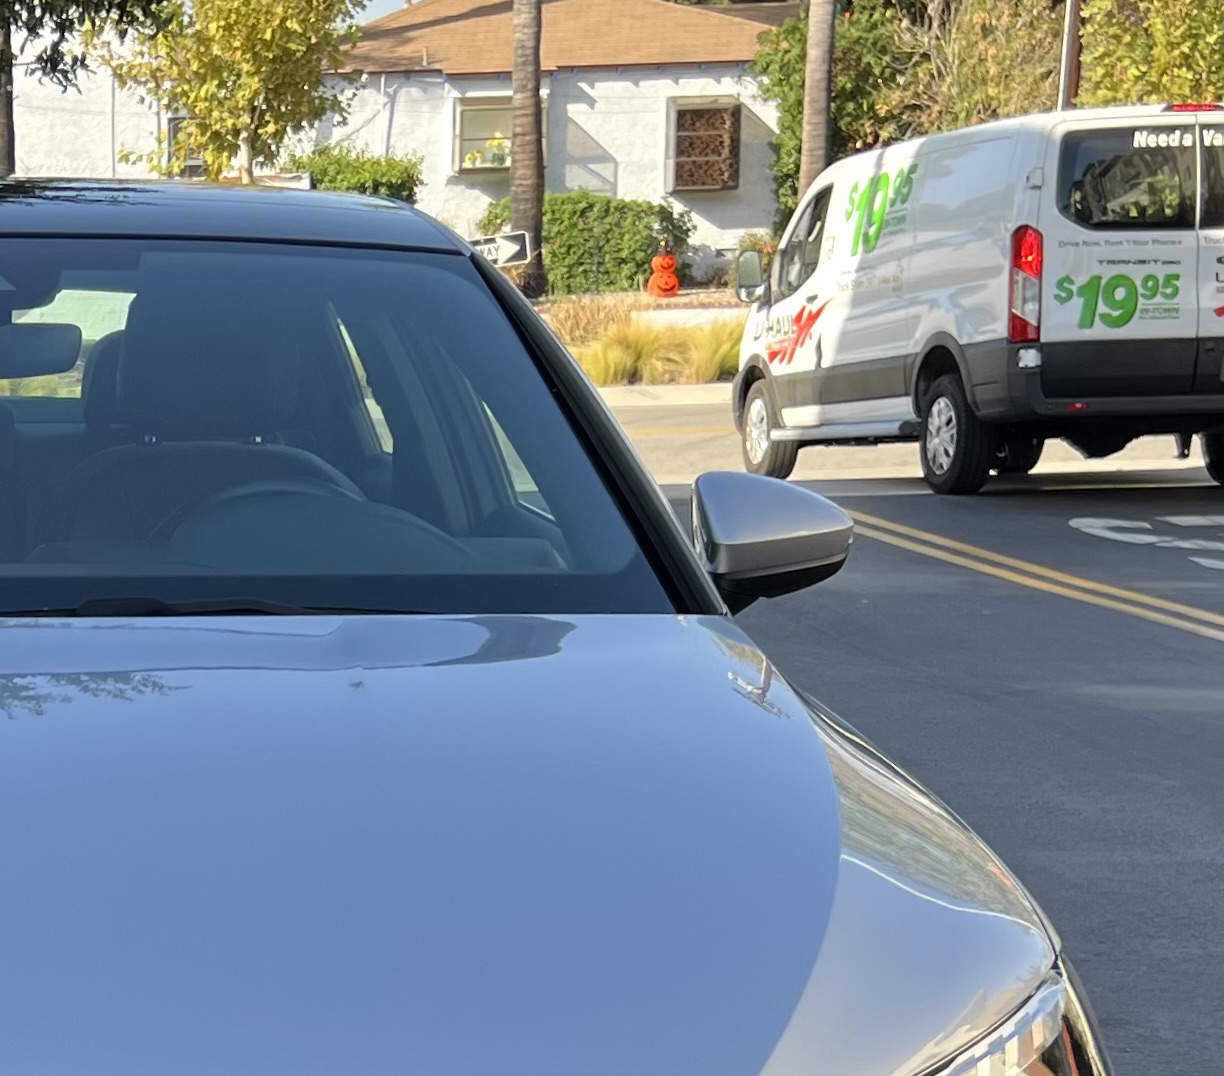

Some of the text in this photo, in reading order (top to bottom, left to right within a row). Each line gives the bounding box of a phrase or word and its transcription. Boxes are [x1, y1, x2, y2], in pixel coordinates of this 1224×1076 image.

[1133, 129, 1224, 148] Need a Va
